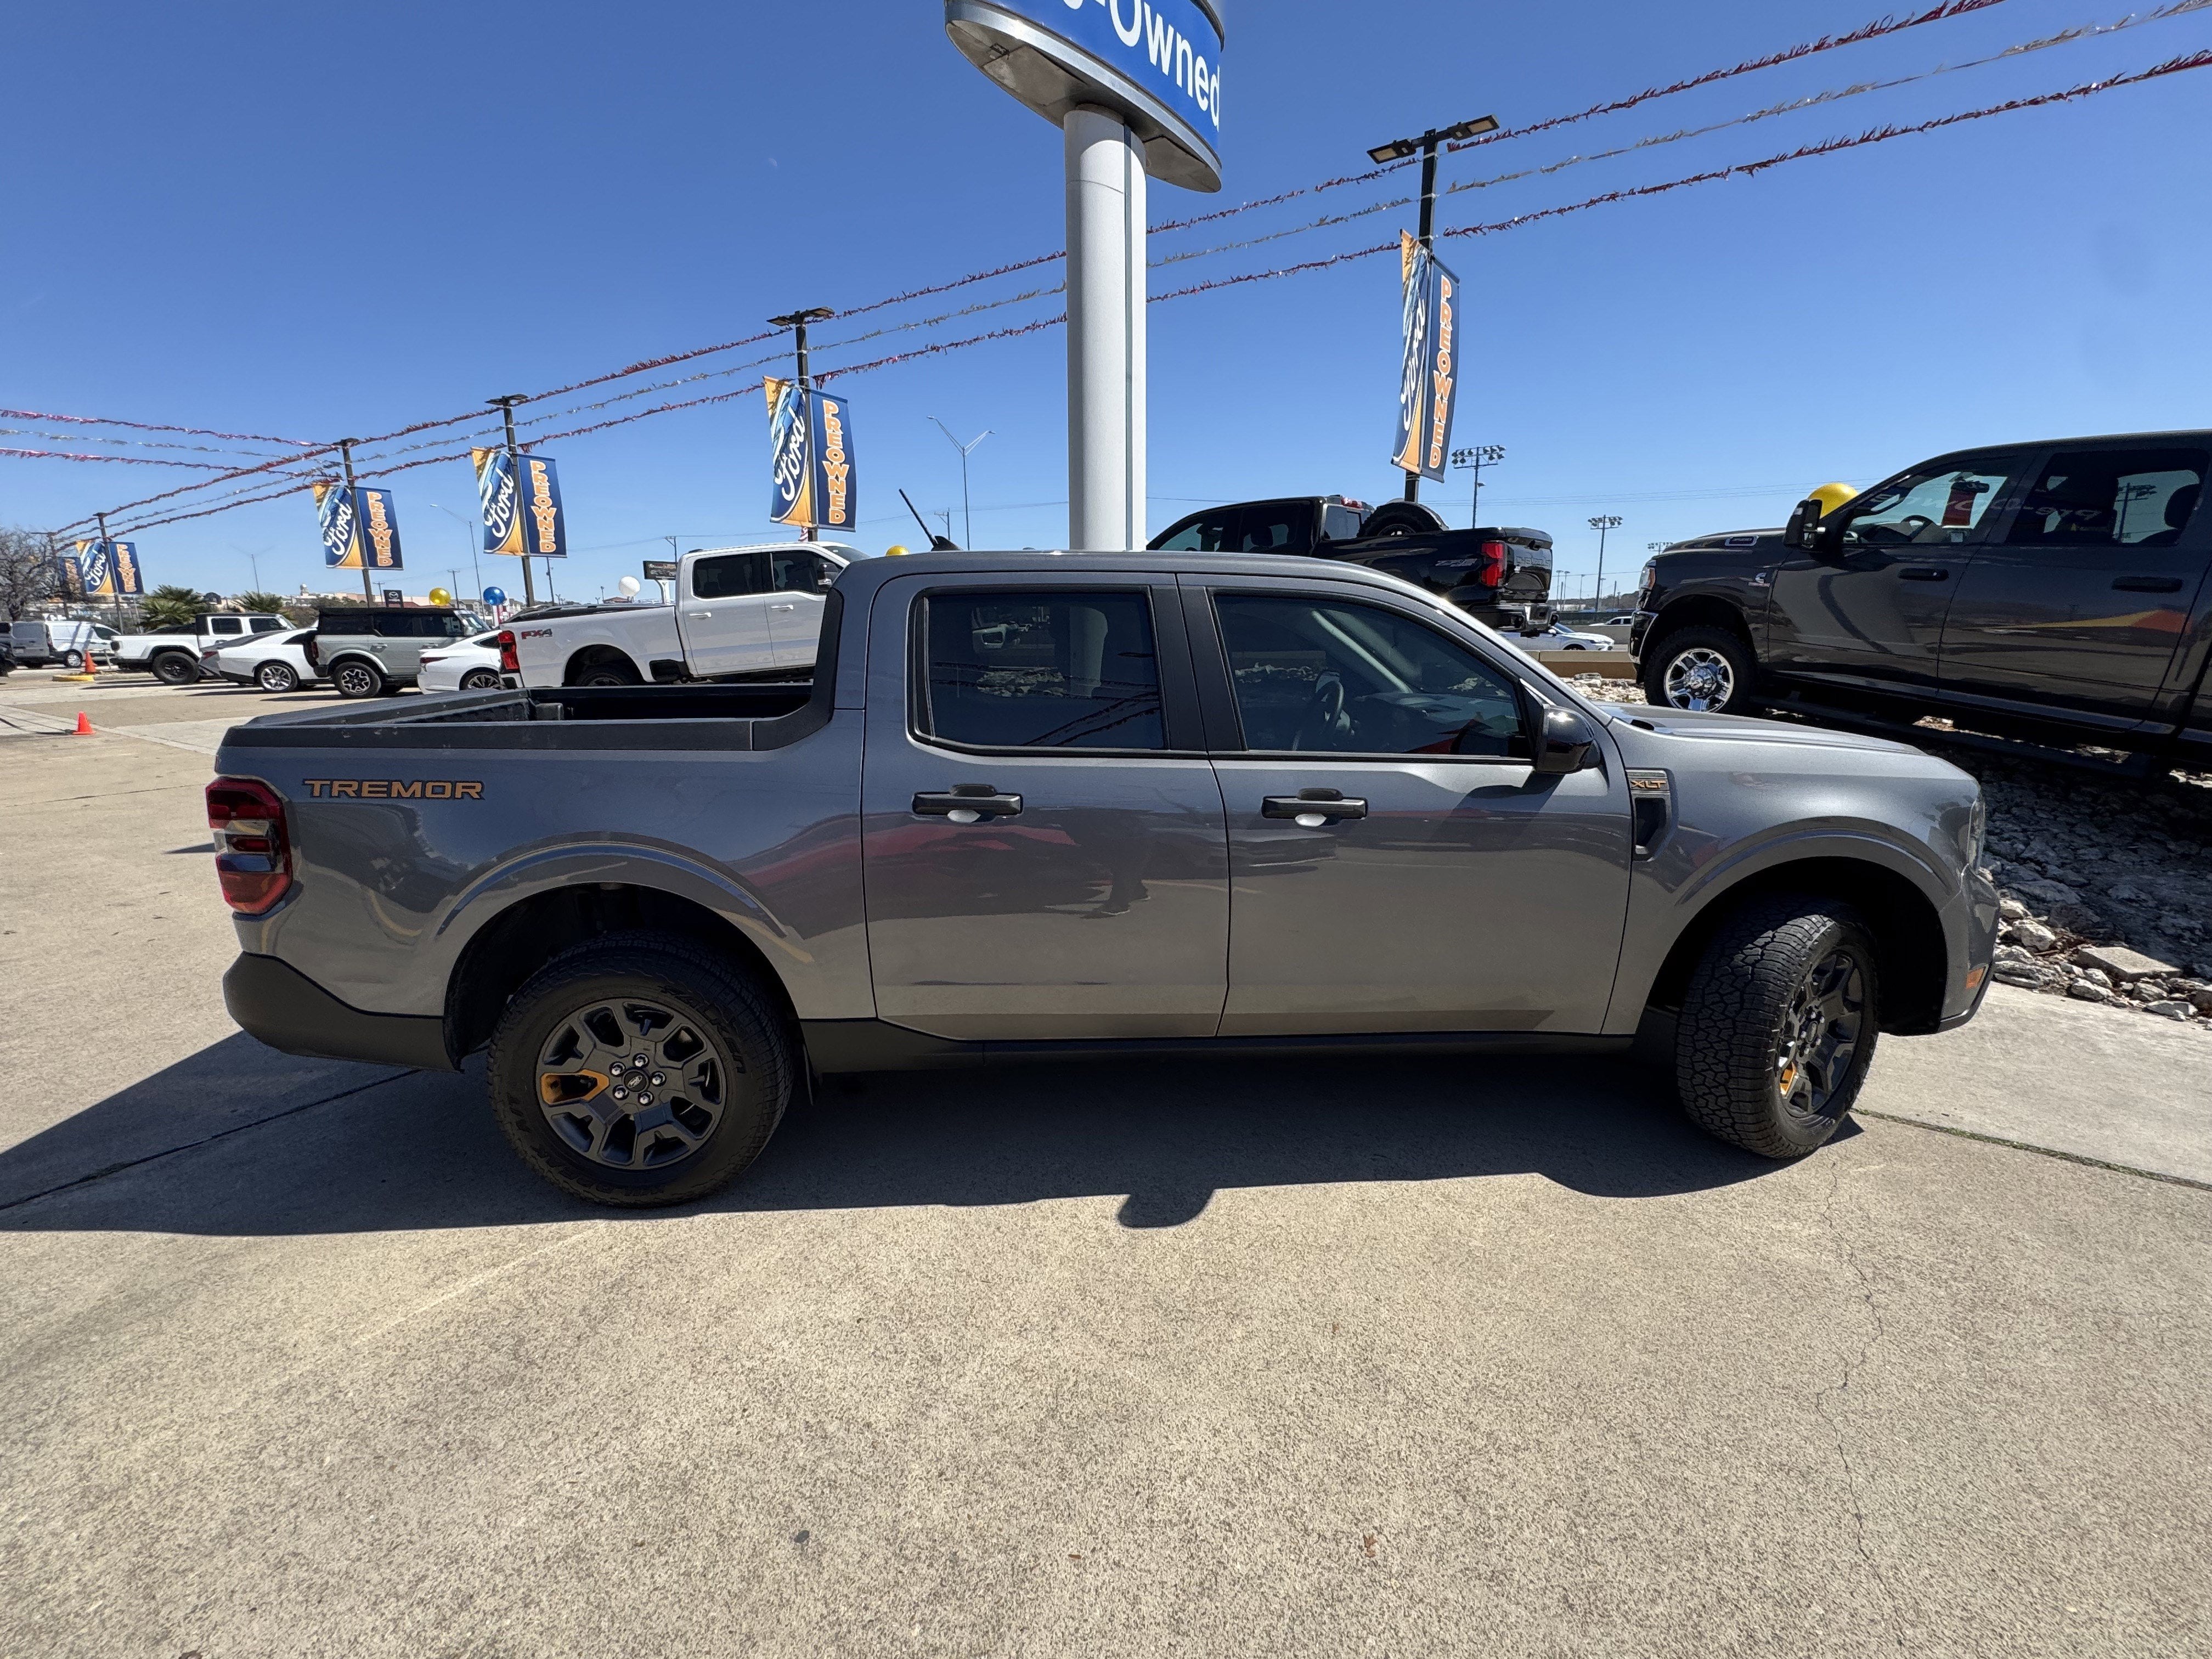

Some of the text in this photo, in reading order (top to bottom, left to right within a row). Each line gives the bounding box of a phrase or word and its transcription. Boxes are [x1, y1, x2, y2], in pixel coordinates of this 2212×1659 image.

[1063, 0, 1220, 132] Owned
[1429, 274, 1453, 469] PREOWNED
[773, 405, 805, 501] Ford
[822, 399, 849, 524] PREOWNED
[323, 498, 352, 555] Ford
[366, 491, 393, 567] PREOWNED
[482, 467, 514, 538] Ford
[530, 460, 557, 552] PREOWNED
[83, 549, 106, 585] Ford
[302, 778, 485, 800] TREMOR
[1630, 780, 1667, 789] XLT
